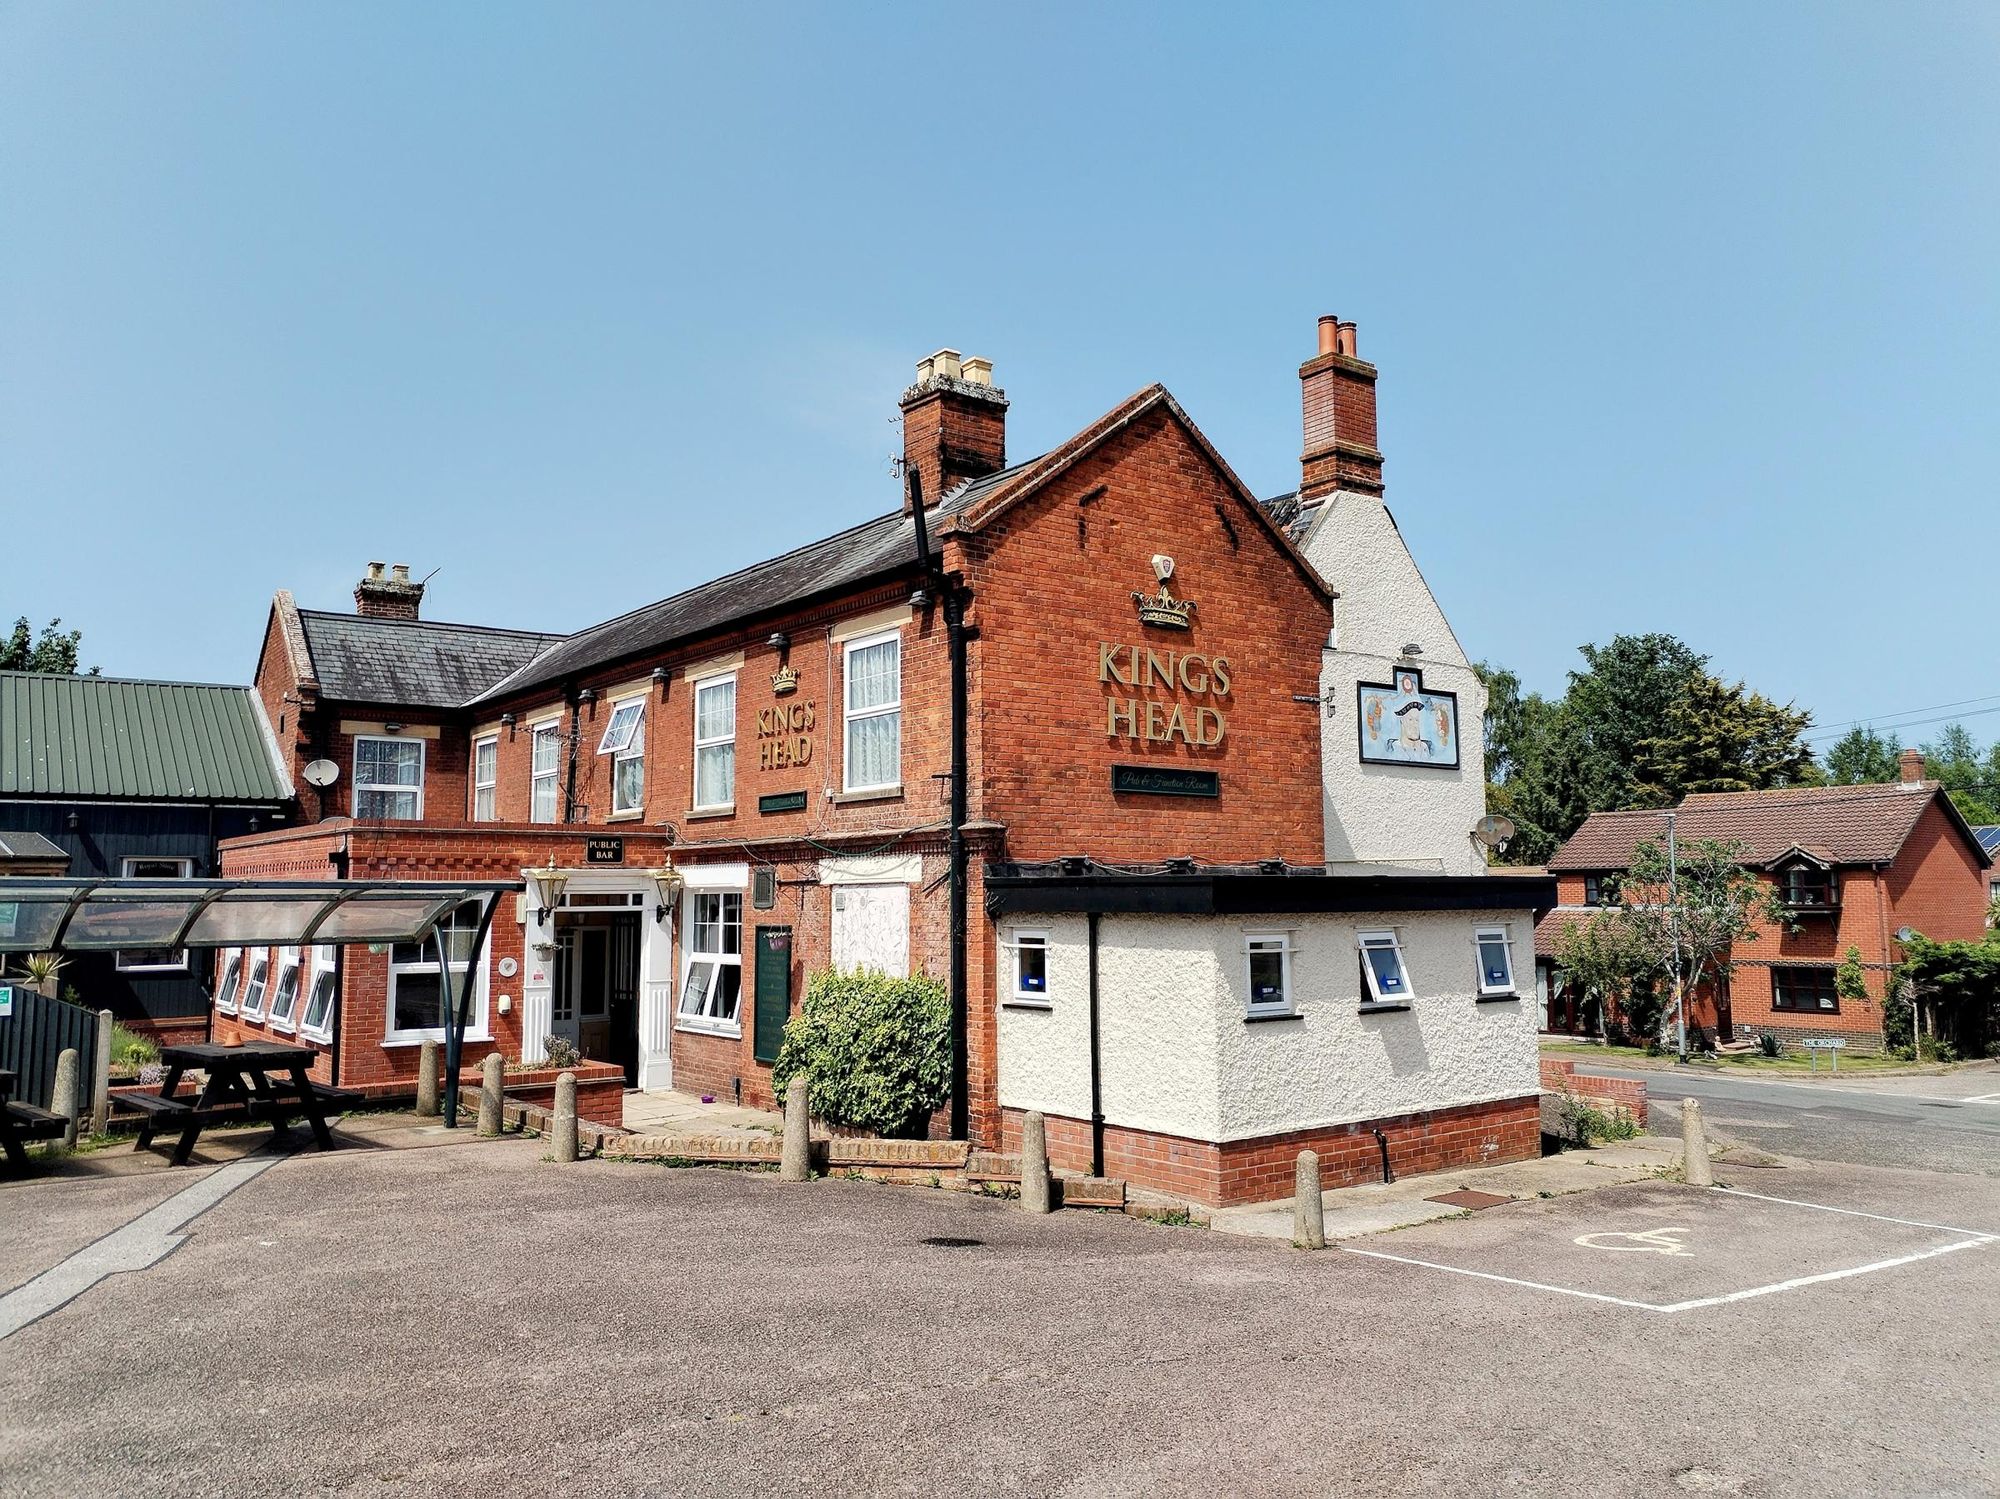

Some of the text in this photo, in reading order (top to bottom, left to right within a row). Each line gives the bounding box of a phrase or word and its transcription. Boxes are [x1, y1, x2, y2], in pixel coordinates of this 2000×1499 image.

[1098, 641, 1230, 695] KINGS
[755, 700, 816, 736] KINGS
[1106, 697, 1225, 745] HEAD
[759, 735, 812, 769] HEAD
[1121, 771, 1140, 786] Pub
[1141, 774, 1151, 786] &
[1185, 775, 1209, 789] Room
[590, 841, 620, 849] PUBLIC
[596, 851, 613, 859] BAR
